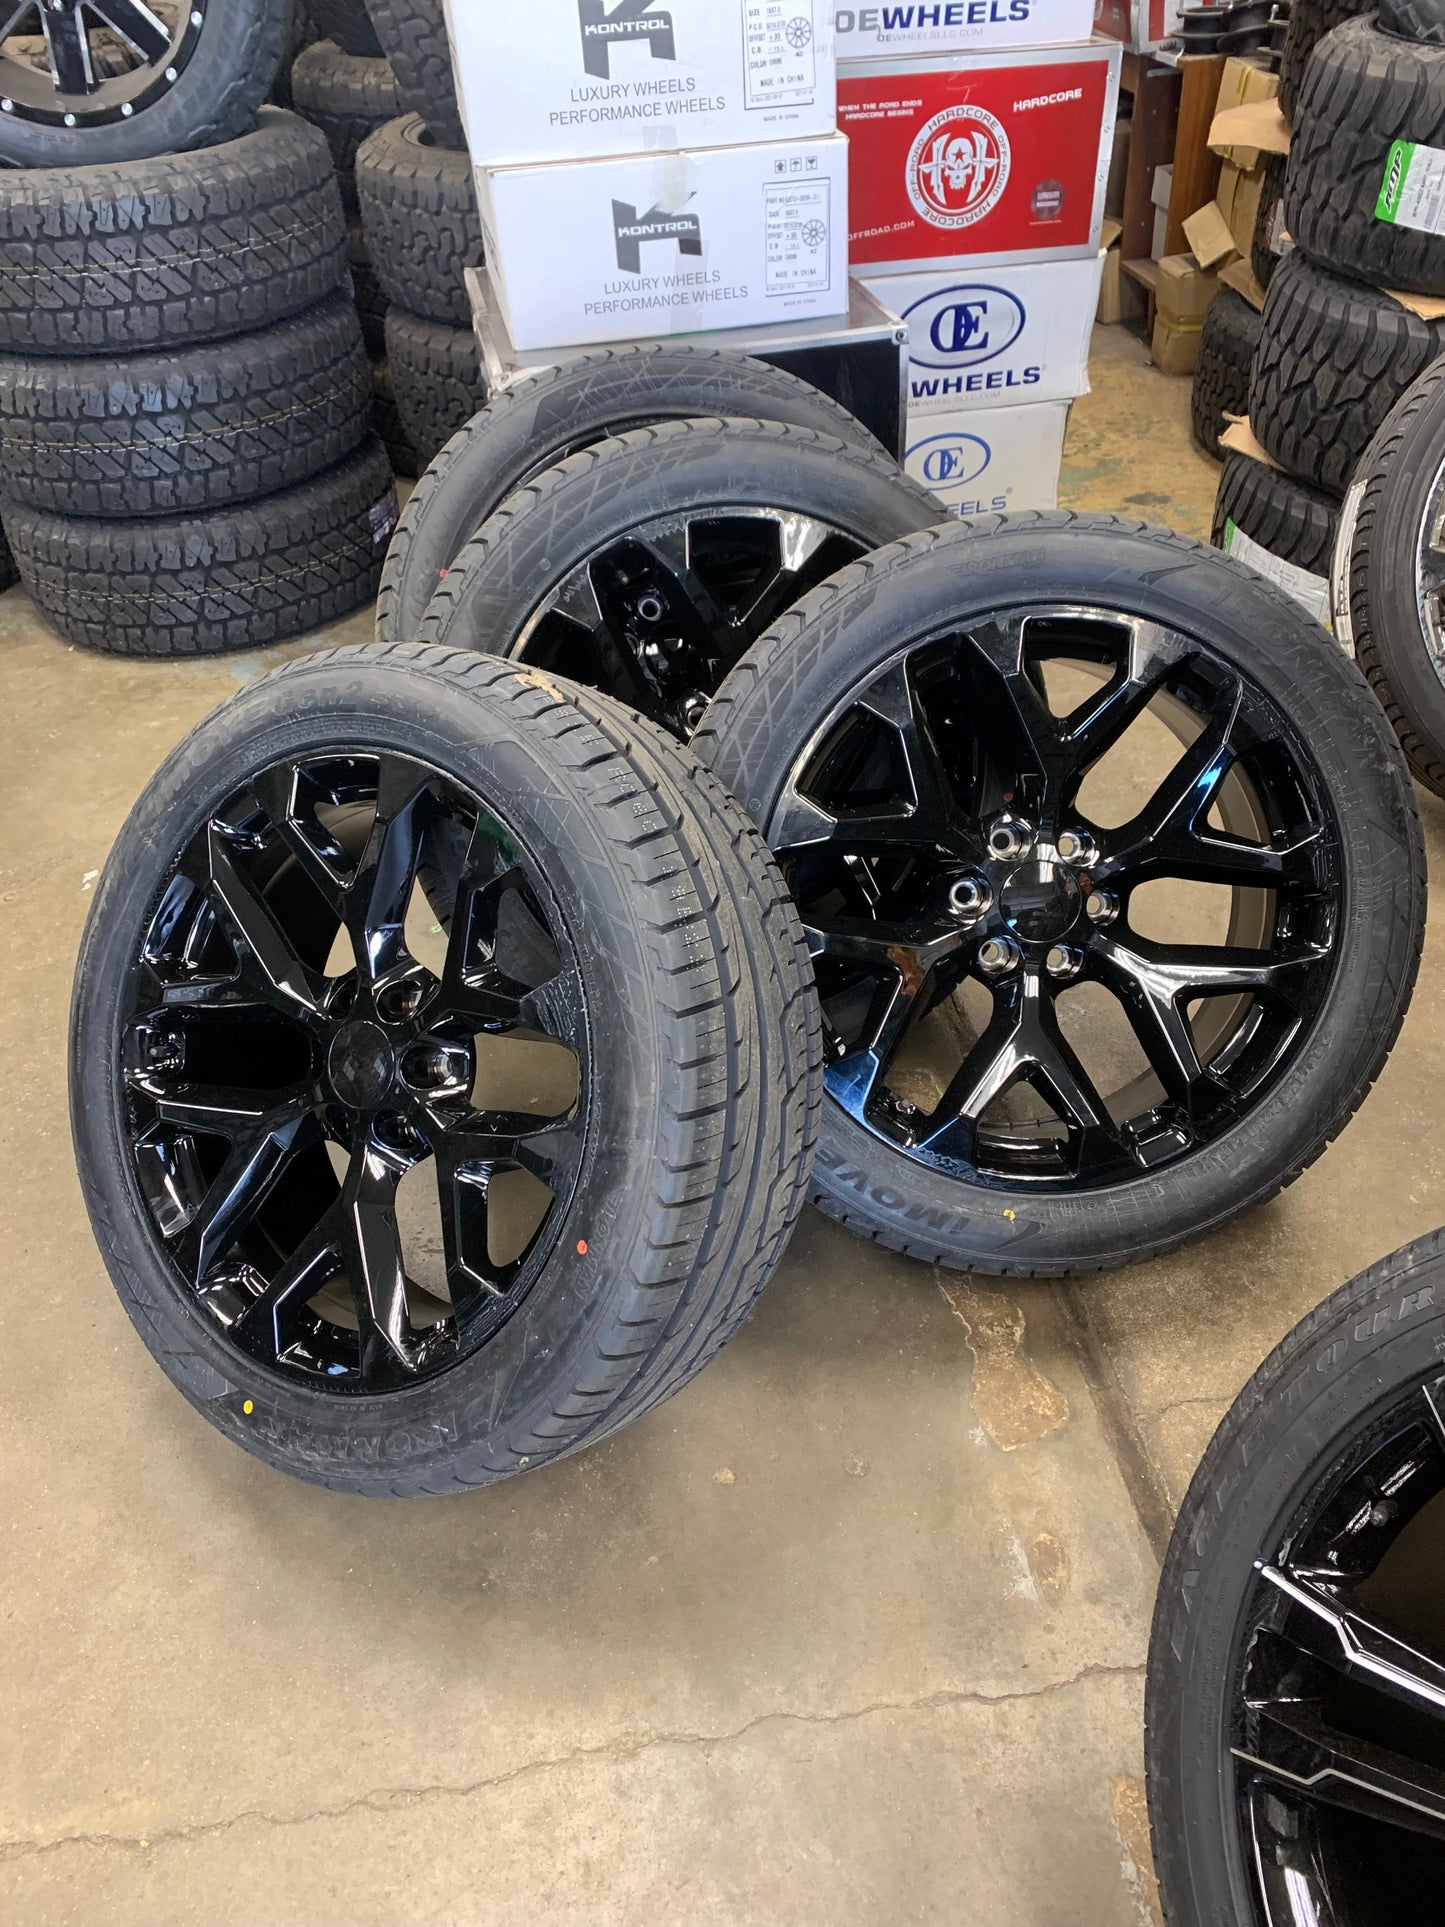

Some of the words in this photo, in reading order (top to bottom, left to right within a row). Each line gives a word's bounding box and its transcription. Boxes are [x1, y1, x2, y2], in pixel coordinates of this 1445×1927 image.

[584, 19, 671, 37] KONTROL
[570, 83, 631, 104] LUXURY
[633, 77, 696, 97] WHEELS
[760, 77, 774, 88] MADE
[777, 76, 785, 84] IN
[786, 73, 805, 83] CHINA
[549, 102, 663, 127] PERFORMANCE
[664, 96, 726, 116] WHEELS
[862, 102, 877, 111] THE
[1012, 87, 1083, 113] HARDCORE
[927, 107, 1000, 132] HARDCORE
[922, 199, 992, 227] HARDCORE
[617, 219, 699, 237] KONTROL
[604, 276, 660, 295] LUXURY
[663, 270, 721, 288] WHEELS
[584, 294, 690, 315] PERFORMANCE
[692, 286, 749, 304] WHEELS
[911, 366, 1041, 398] WHEELS
